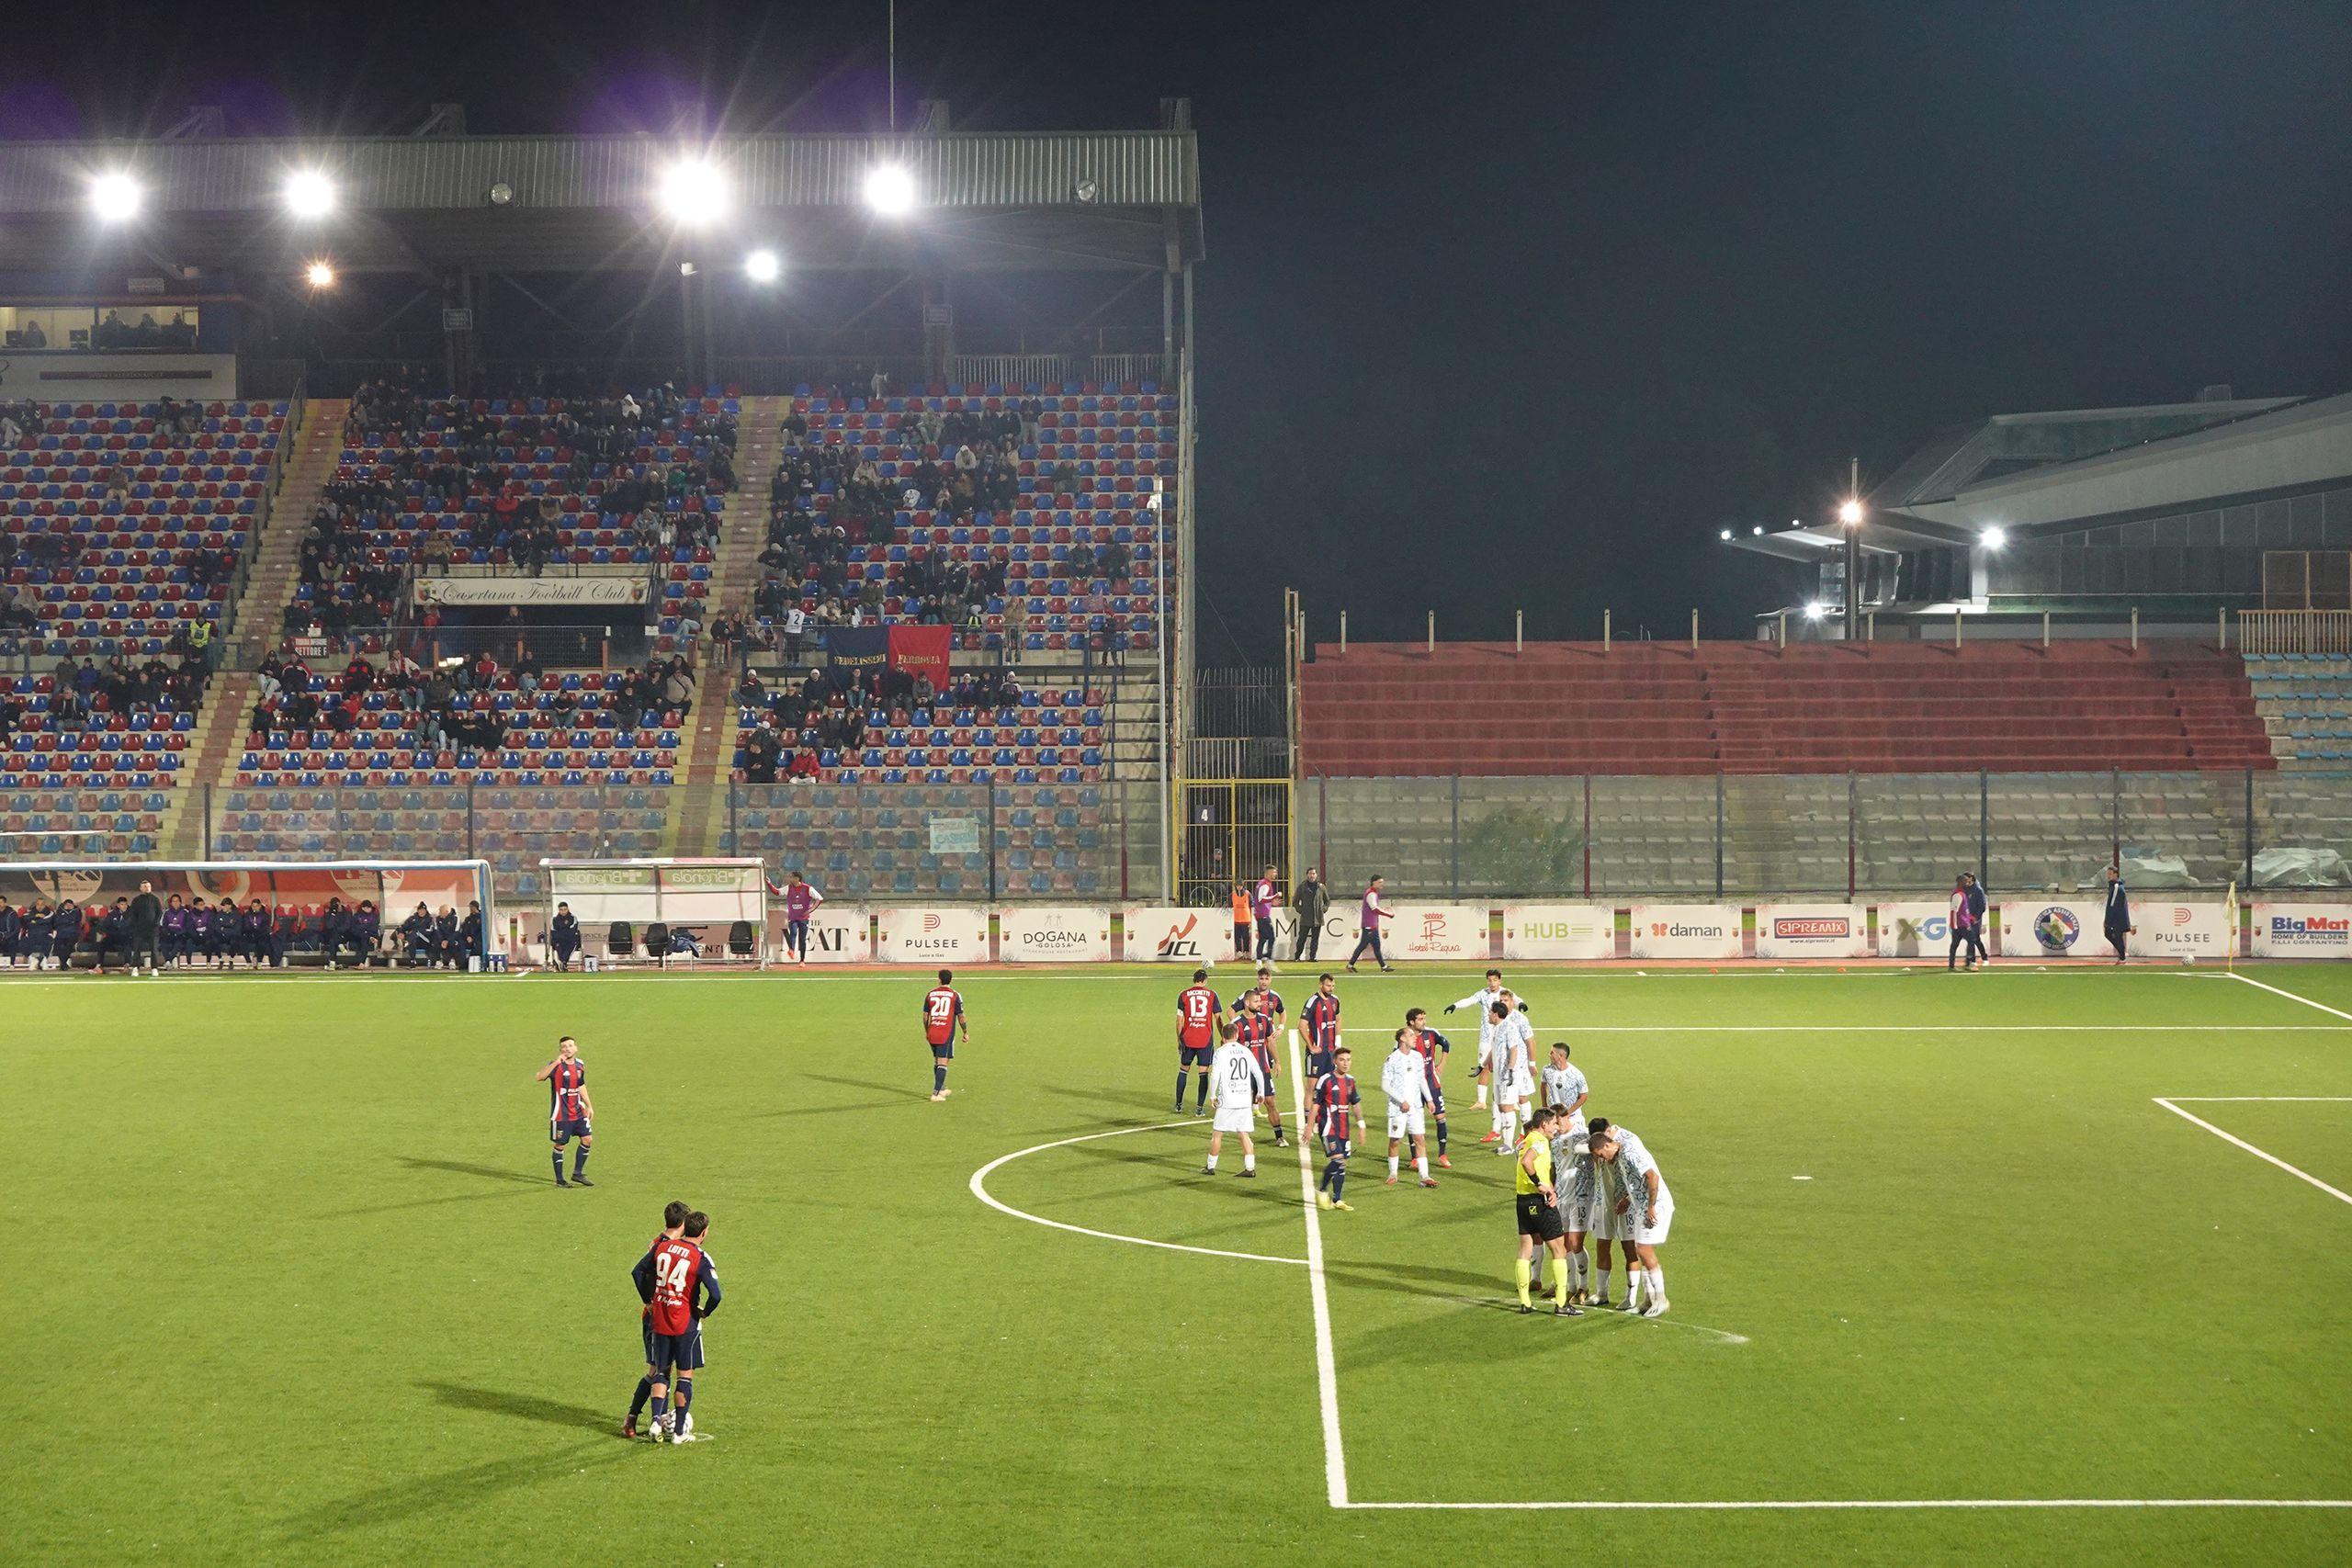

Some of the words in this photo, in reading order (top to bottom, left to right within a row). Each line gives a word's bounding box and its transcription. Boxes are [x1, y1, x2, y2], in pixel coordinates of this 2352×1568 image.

[438, 581, 516, 600] Casertana
[520, 582, 583, 599] Football
[587, 581, 626, 599] Club
[794, 614, 800, 625] 2
[1201, 809, 1208, 821] 4
[1524, 923, 1568, 939] HUB
[1669, 923, 1722, 936] daman
[1780, 922, 1845, 933] SIPREMIX
[2271, 917, 2349, 933] BigMat
[905, 939, 958, 948] PULSEE
[1023, 931, 1087, 944] DOGANA
[2155, 933, 2210, 942] PULSEE
[1157, 941, 1202, 955] JCL
[1408, 942, 1430, 952] Hotel
[930, 997, 951, 1017] 20
[1189, 996, 1208, 1018] 13
[1229, 1057, 1248, 1080] 20
[1577, 1206, 1587, 1218] 13
[1625, 1213, 1634, 1225] 18
[656, 1252, 691, 1292] 94
